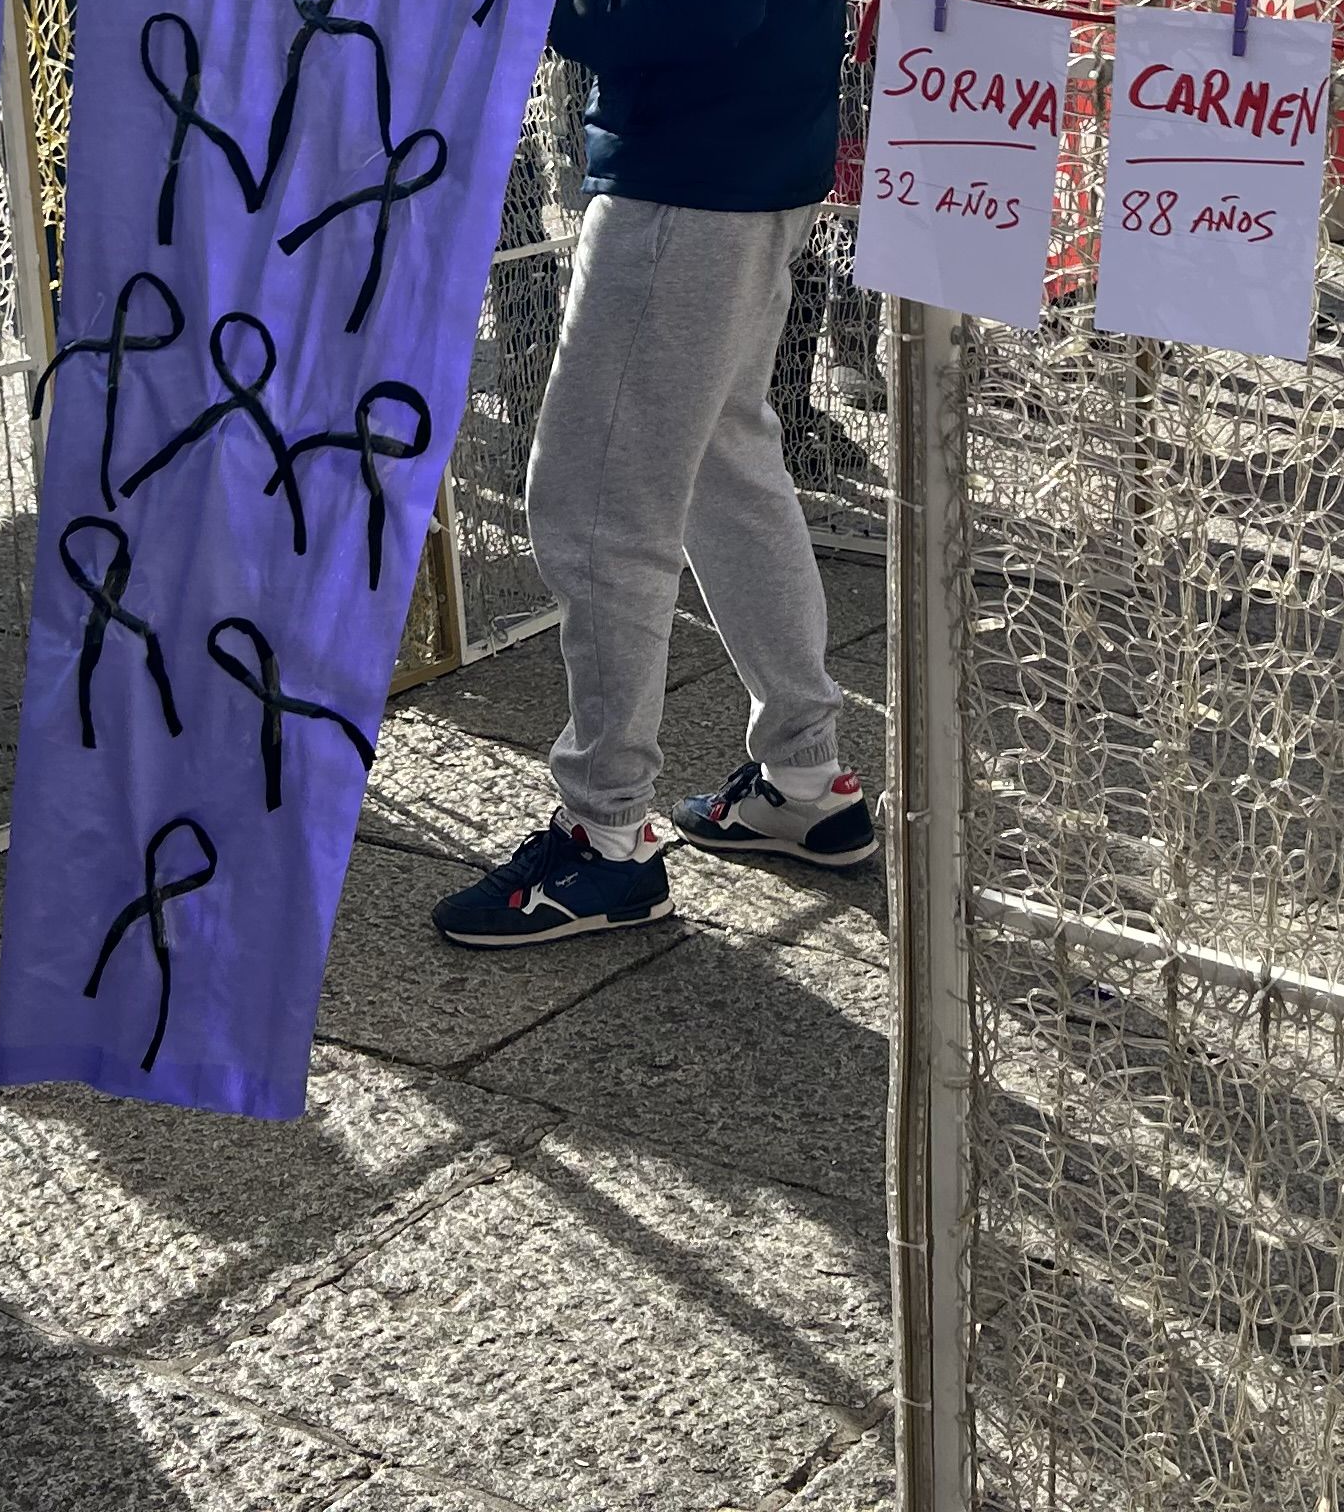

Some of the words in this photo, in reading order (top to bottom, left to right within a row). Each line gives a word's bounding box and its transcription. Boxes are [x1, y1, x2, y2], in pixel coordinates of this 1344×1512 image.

[884, 46, 1058, 137] SORAYA
[1128, 63, 1328, 147] CARMEN
[875, 167, 920, 206] 32
[935, 182, 1020, 230] AÑOS
[1121, 189, 1179, 236] 88
[1190, 195, 1276, 242] AÑOS
